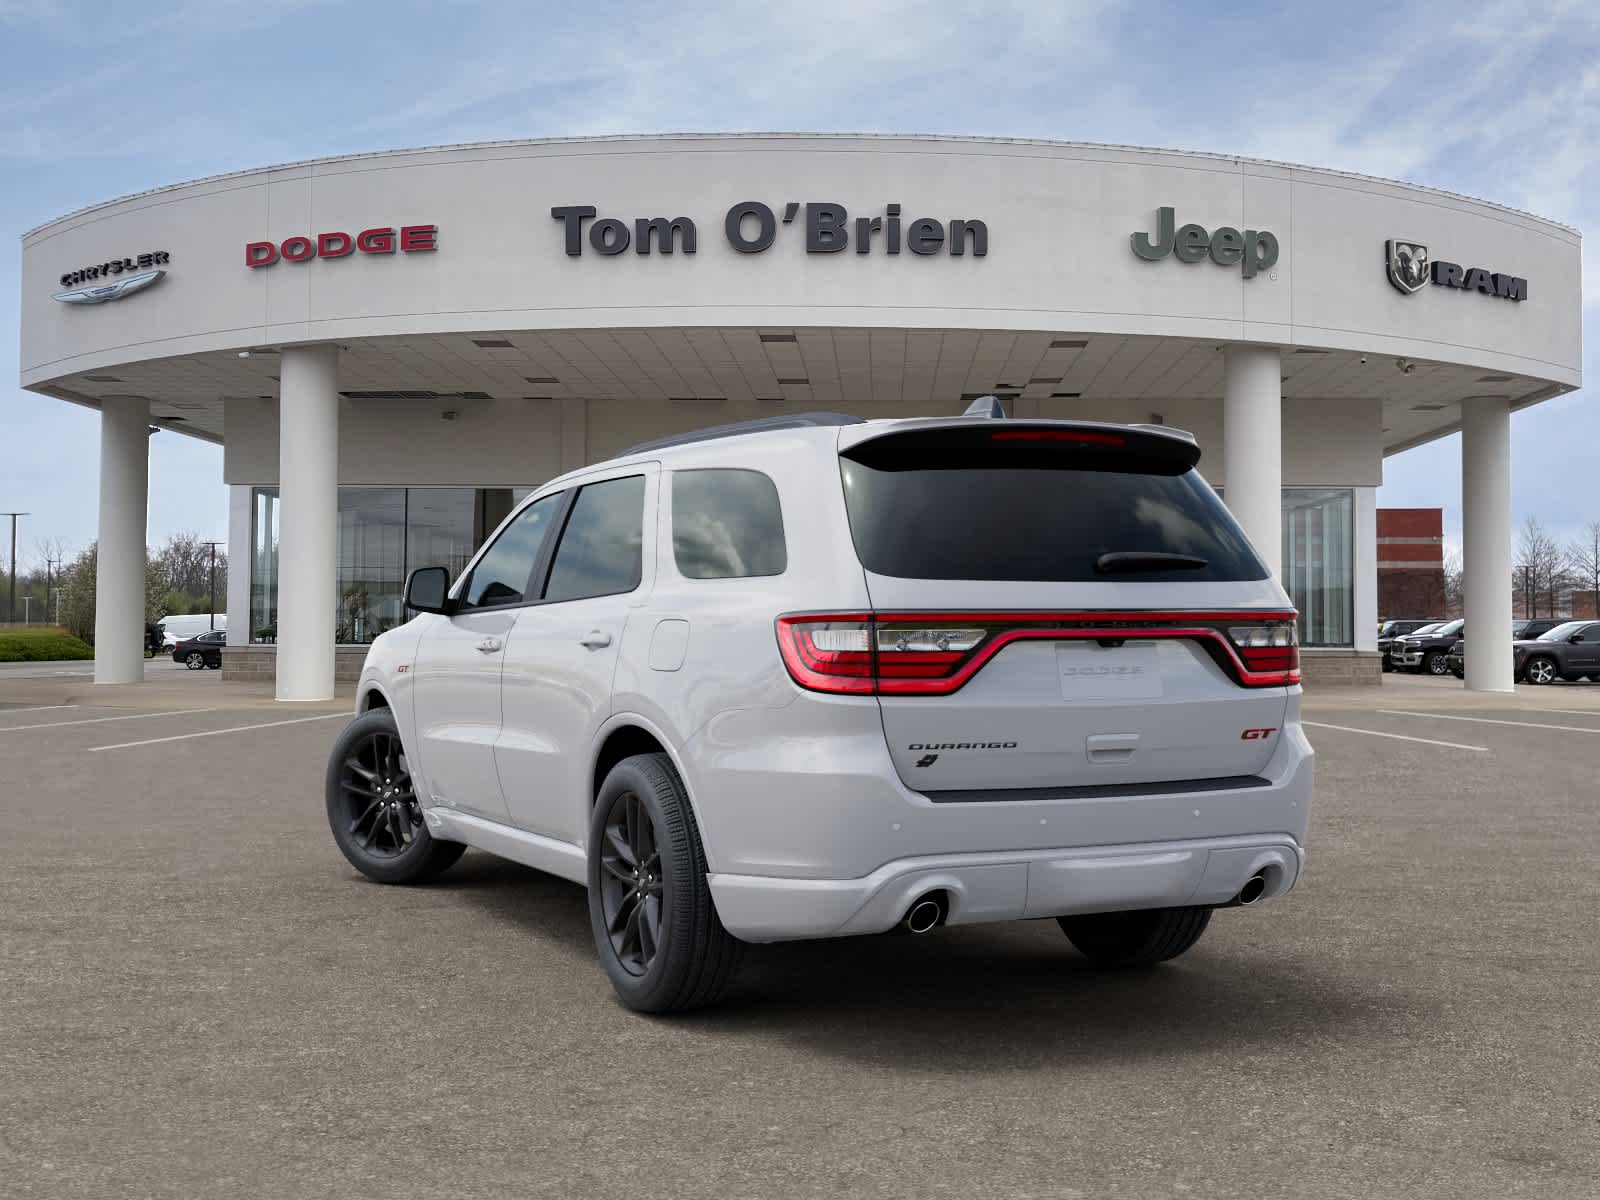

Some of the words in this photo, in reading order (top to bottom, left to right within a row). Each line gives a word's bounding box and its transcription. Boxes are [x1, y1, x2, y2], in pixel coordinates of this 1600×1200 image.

[245, 224, 438, 269] DODGE
[551, 205, 697, 256] Tom
[1130, 207, 1280, 279] Jeep
[60, 250, 170, 287] CHRYSLER
[1430, 260, 1528, 302] RAM
[397, 664, 410, 673] GT
[908, 741, 1019, 751] DURANGO
[1241, 727, 1278, 741] GT
